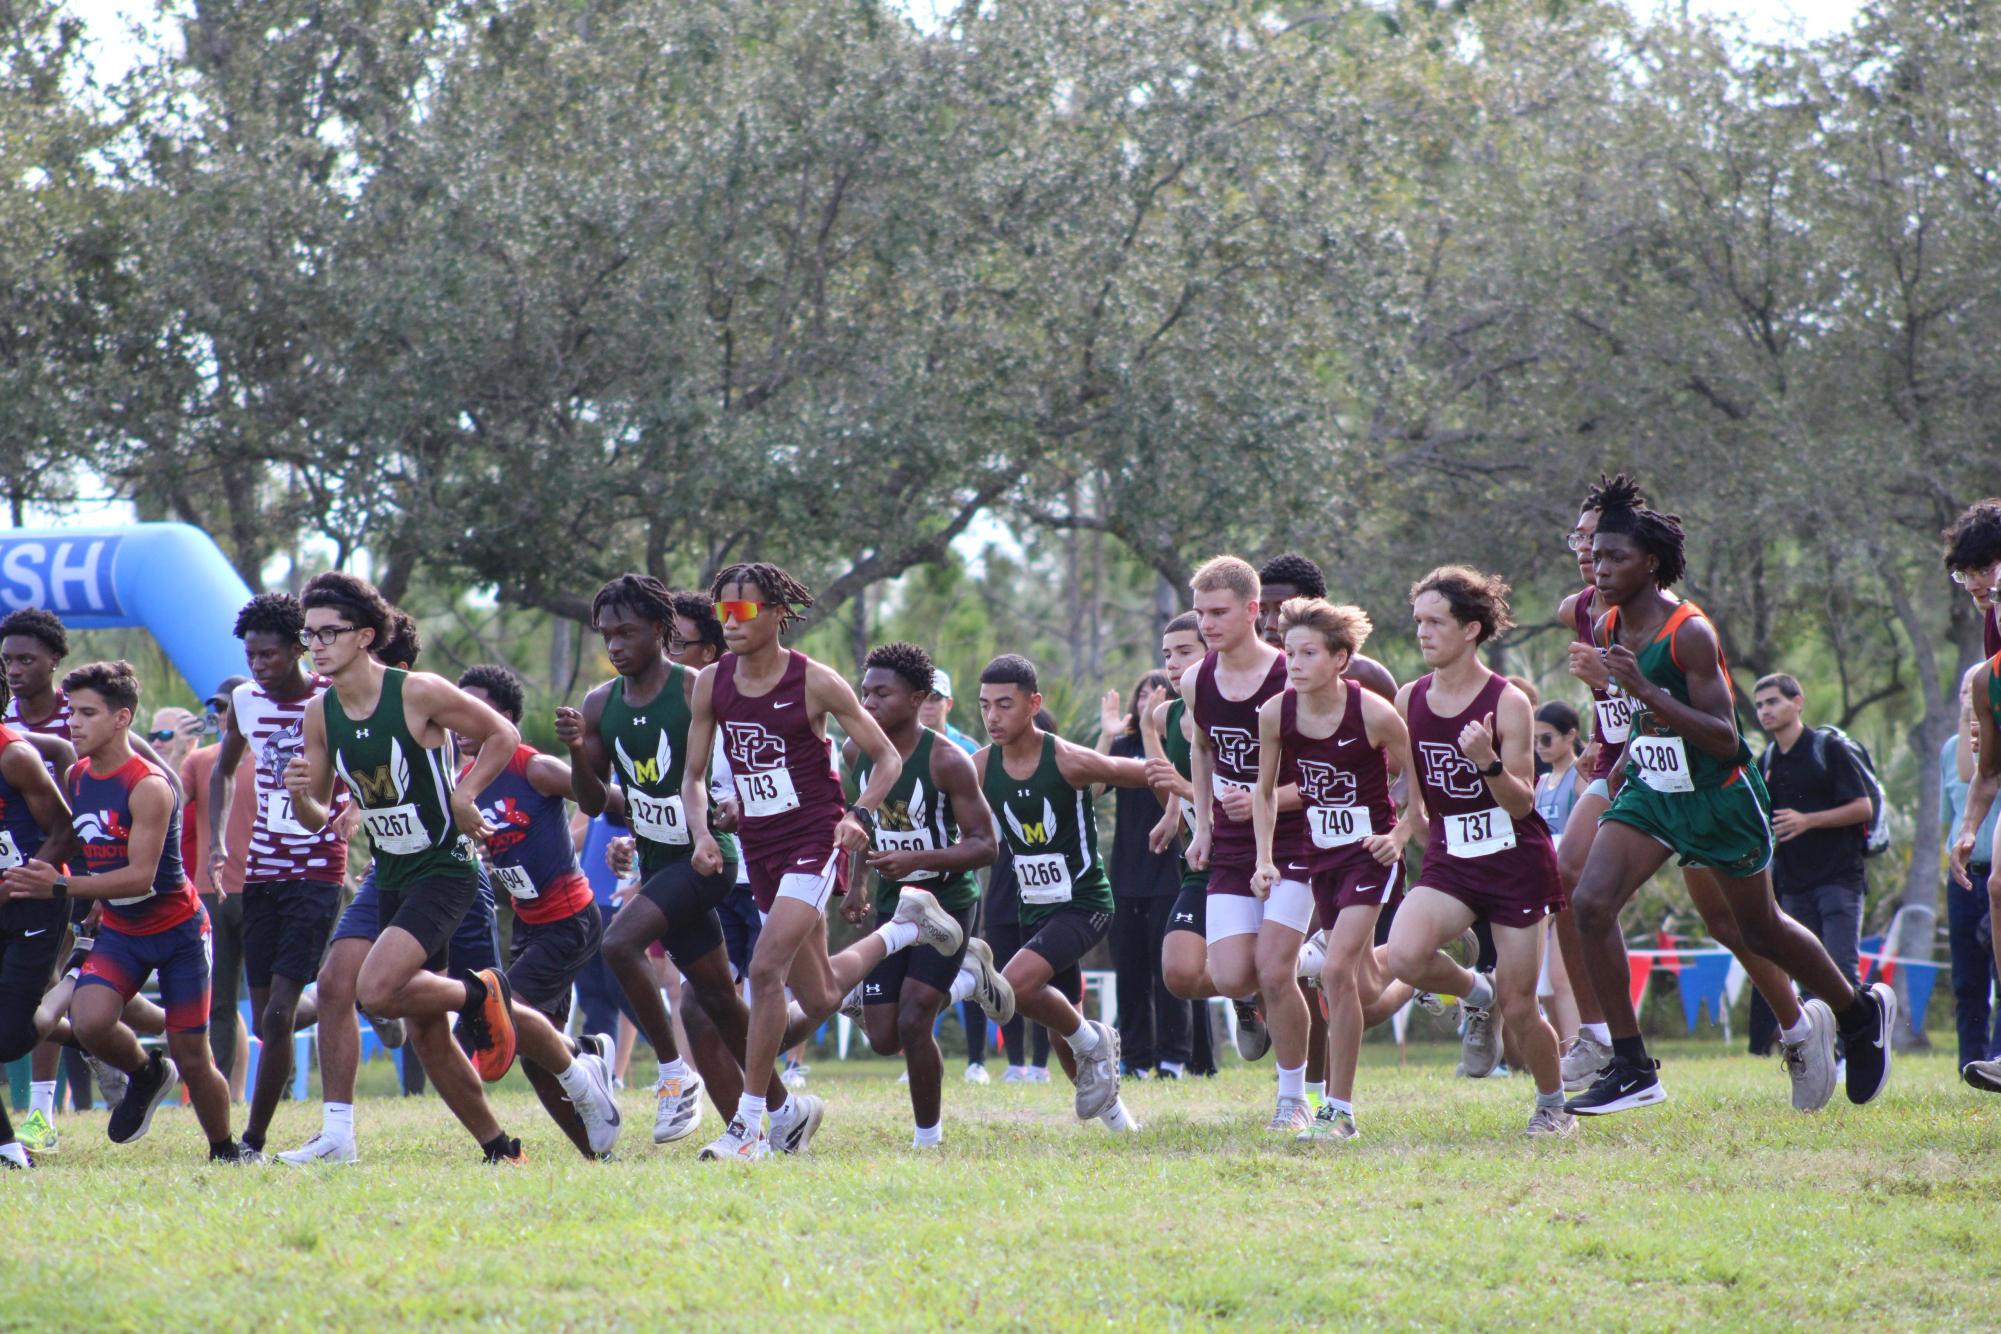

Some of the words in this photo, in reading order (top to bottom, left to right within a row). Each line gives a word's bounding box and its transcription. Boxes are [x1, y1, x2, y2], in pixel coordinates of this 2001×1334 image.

[1600, 701, 1631, 728] 739
[634, 757, 658, 784] M
[1636, 745, 1678, 772] 1280
[351, 764, 399, 804] M
[743, 774, 777, 802] 743
[368, 813, 414, 837] 1267
[634, 798, 677, 827] 1270
[1317, 809, 1354, 835] 740
[1022, 822, 1047, 843] M
[1457, 811, 1492, 843] 737
[1019, 861, 1062, 886] 1266
